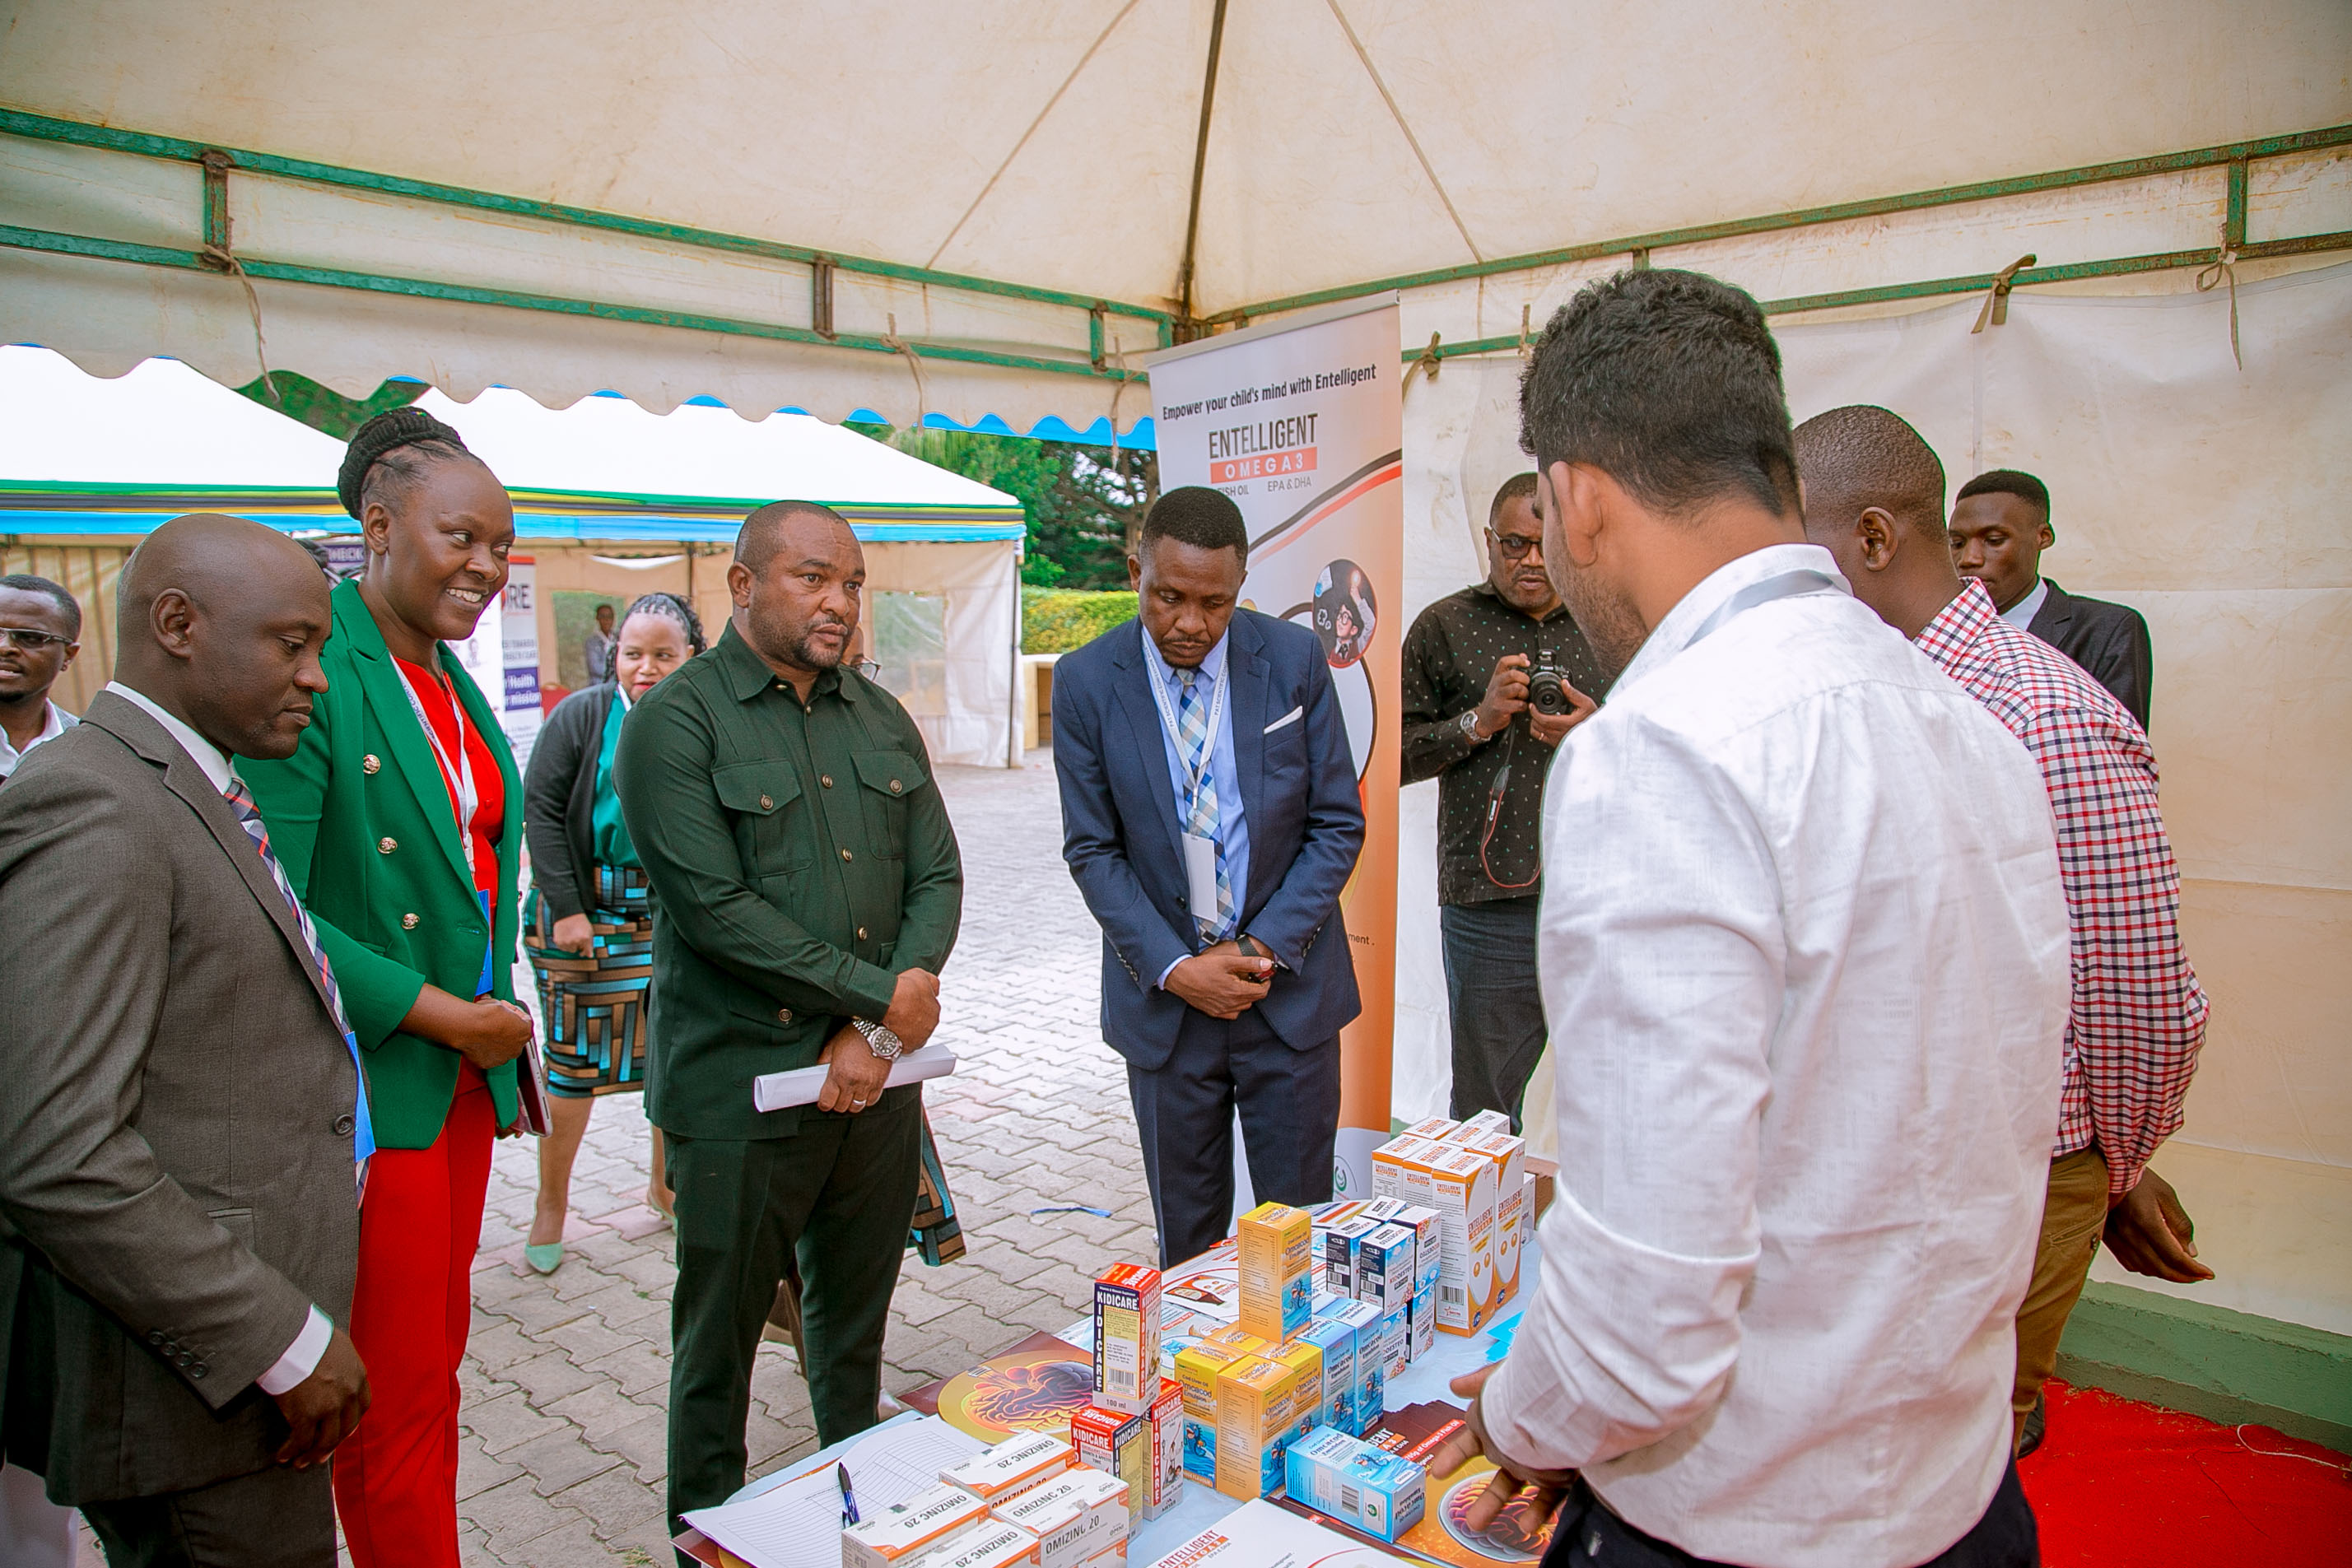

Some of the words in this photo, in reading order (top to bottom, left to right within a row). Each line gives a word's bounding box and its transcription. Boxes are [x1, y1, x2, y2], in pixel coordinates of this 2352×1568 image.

[1162, 401, 1203, 420] Empower
[1206, 396, 1227, 414] your
[1230, 387, 1259, 407] child's
[1261, 382, 1287, 401] mind
[1290, 375, 1311, 394] with
[1316, 364, 1376, 389] Entelligent
[1209, 412, 1318, 459] ENTELLIGENT
[1237, 485, 1249, 496] OIL
[1268, 480, 1285, 492] EPA
[1285, 479, 1292, 489] &
[1294, 477, 1311, 489] DHA
[1216, 677, 1225, 704] SCIENTIFIC
[1097, 1291, 1139, 1310] KIDICARE
[1106, 1399, 1117, 1407] 100
[1154, 1395, 1182, 1420] KIDICARE
[1074, 1427, 1111, 1449] KIDICARE
[1115, 1421, 1142, 1447] KIDICARE
[1310, 1433, 1344, 1456] Omcacod
[1012, 1440, 1055, 1461] OMIZINC
[997, 1459, 1013, 1468] 20
[919, 1495, 967, 1520] OMIZINC
[1013, 1491, 1058, 1517] OMIZINC
[1057, 1484, 1071, 1495] 20
[904, 1517, 920, 1528] 20
[1046, 1524, 1086, 1555] OMIZINC
[1089, 1514, 1099, 1529] 20
[971, 1531, 1018, 1560] OMIZINC
[1158, 1529, 1219, 1568] ENTELLIGENT
[955, 1556, 972, 1568] 20
